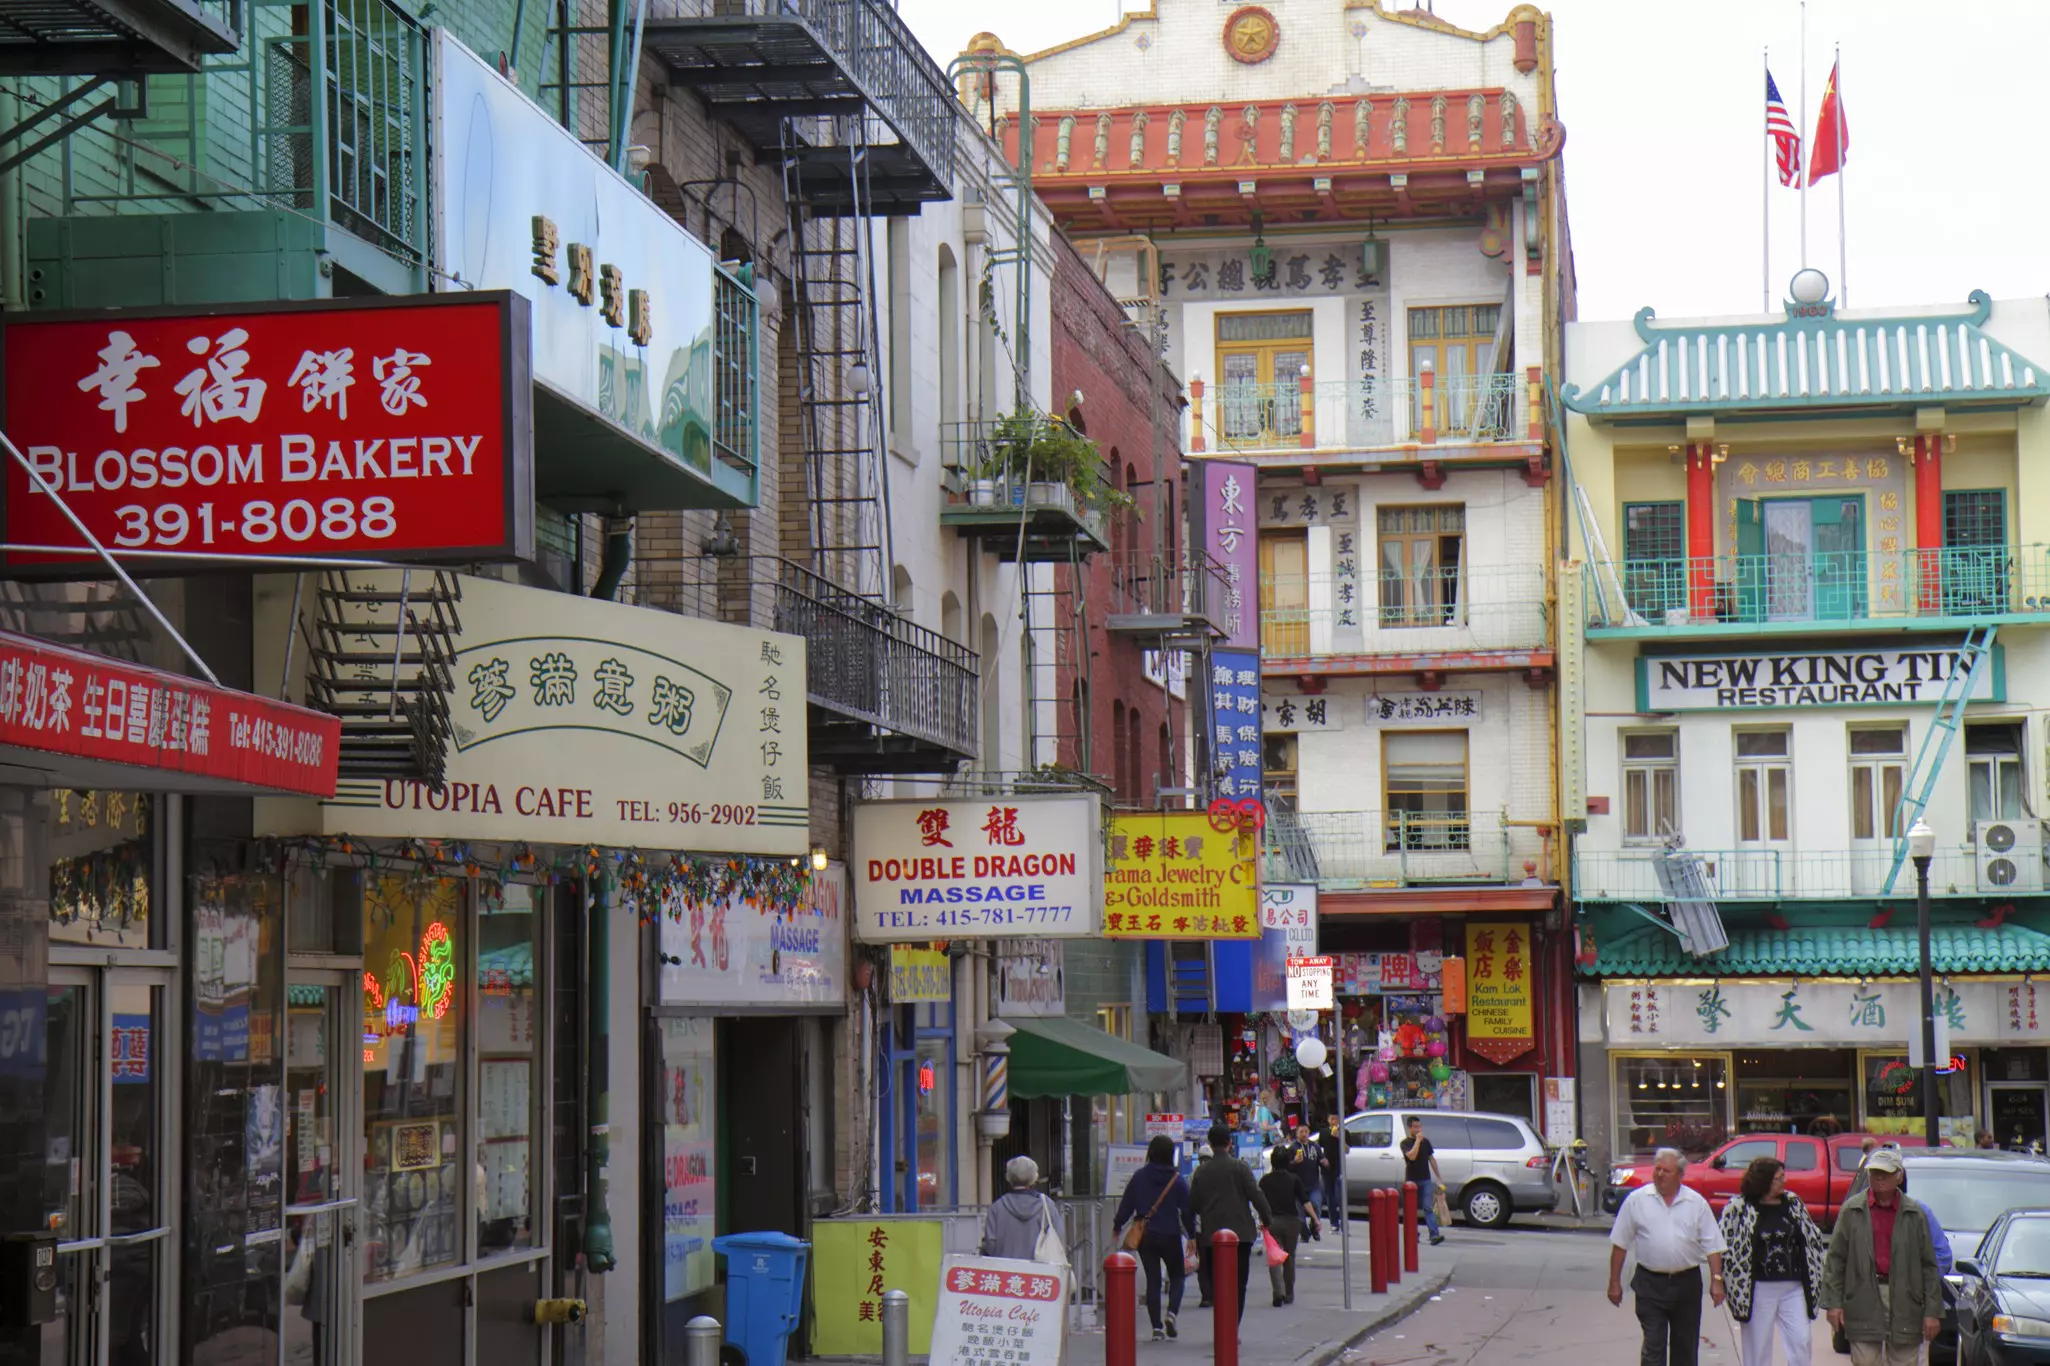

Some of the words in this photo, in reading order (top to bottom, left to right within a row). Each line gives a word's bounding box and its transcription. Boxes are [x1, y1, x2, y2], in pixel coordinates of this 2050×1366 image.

[77, 327, 432, 434] 幸福餅家
[27, 442, 264, 494] BLOSSOM
[280, 432, 483, 483] BAKERY
[113, 495, 397, 548] 391-8088
[1659, 657, 1763, 690] NEW
[1768, 653, 1889, 687] KING
[1896, 651, 1976, 682] TIN
[1717, 682, 1922, 707] RESTAURANT
[759, 640, 784, 800] 馳名煲仔飯
[1262, 697, 1327, 727] 胡家
[229, 712, 250, 748] Tel:
[252, 718, 323, 767] 415-391-8088
[1236, 669, 1260, 796] 理財保險行
[384, 779, 503, 814] UTOPIA
[515, 785, 593, 818] CAFE
[617, 800, 659, 823] TEL:
[669, 801, 756, 827] 956-2902
[917, 805, 1025, 848] 雙龍
[868, 856, 965, 883] DOUBLE
[974, 852, 1076, 879] DRAGON
[1156, 862, 1226, 889] Jewelry
[900, 884, 1046, 905] MASSAGE
[1126, 885, 1221, 908] Goldsmith
[874, 911, 929, 929] TEL:
[935, 905, 1073, 927] 415-781-7777
[1102, 912, 1162, 932] 寶玉石
[771, 925, 819, 953] MASSAGE
[1381, 954, 1410, 984] 牌
[1473, 930, 1495, 979] 飯店
[1288, 965, 1301, 978] NO
[1302, 967, 1331, 977] STOPPING
[1302, 980, 1318, 988] ANY
[434, 981, 453, 1020] BEER
[1301, 989, 1320, 998] TIME
[1472, 996, 1526, 1007] Restaurant
[1475, 983, 1498, 994] Kam
[1503, 982, 1521, 994] Lok
[1472, 1008, 1509, 1016] CHINESE
[866, 1226, 889, 1297] 安東尼
[960, 1299, 1004, 1321] Utopia
[1008, 1304, 1040, 1327] Cafe
